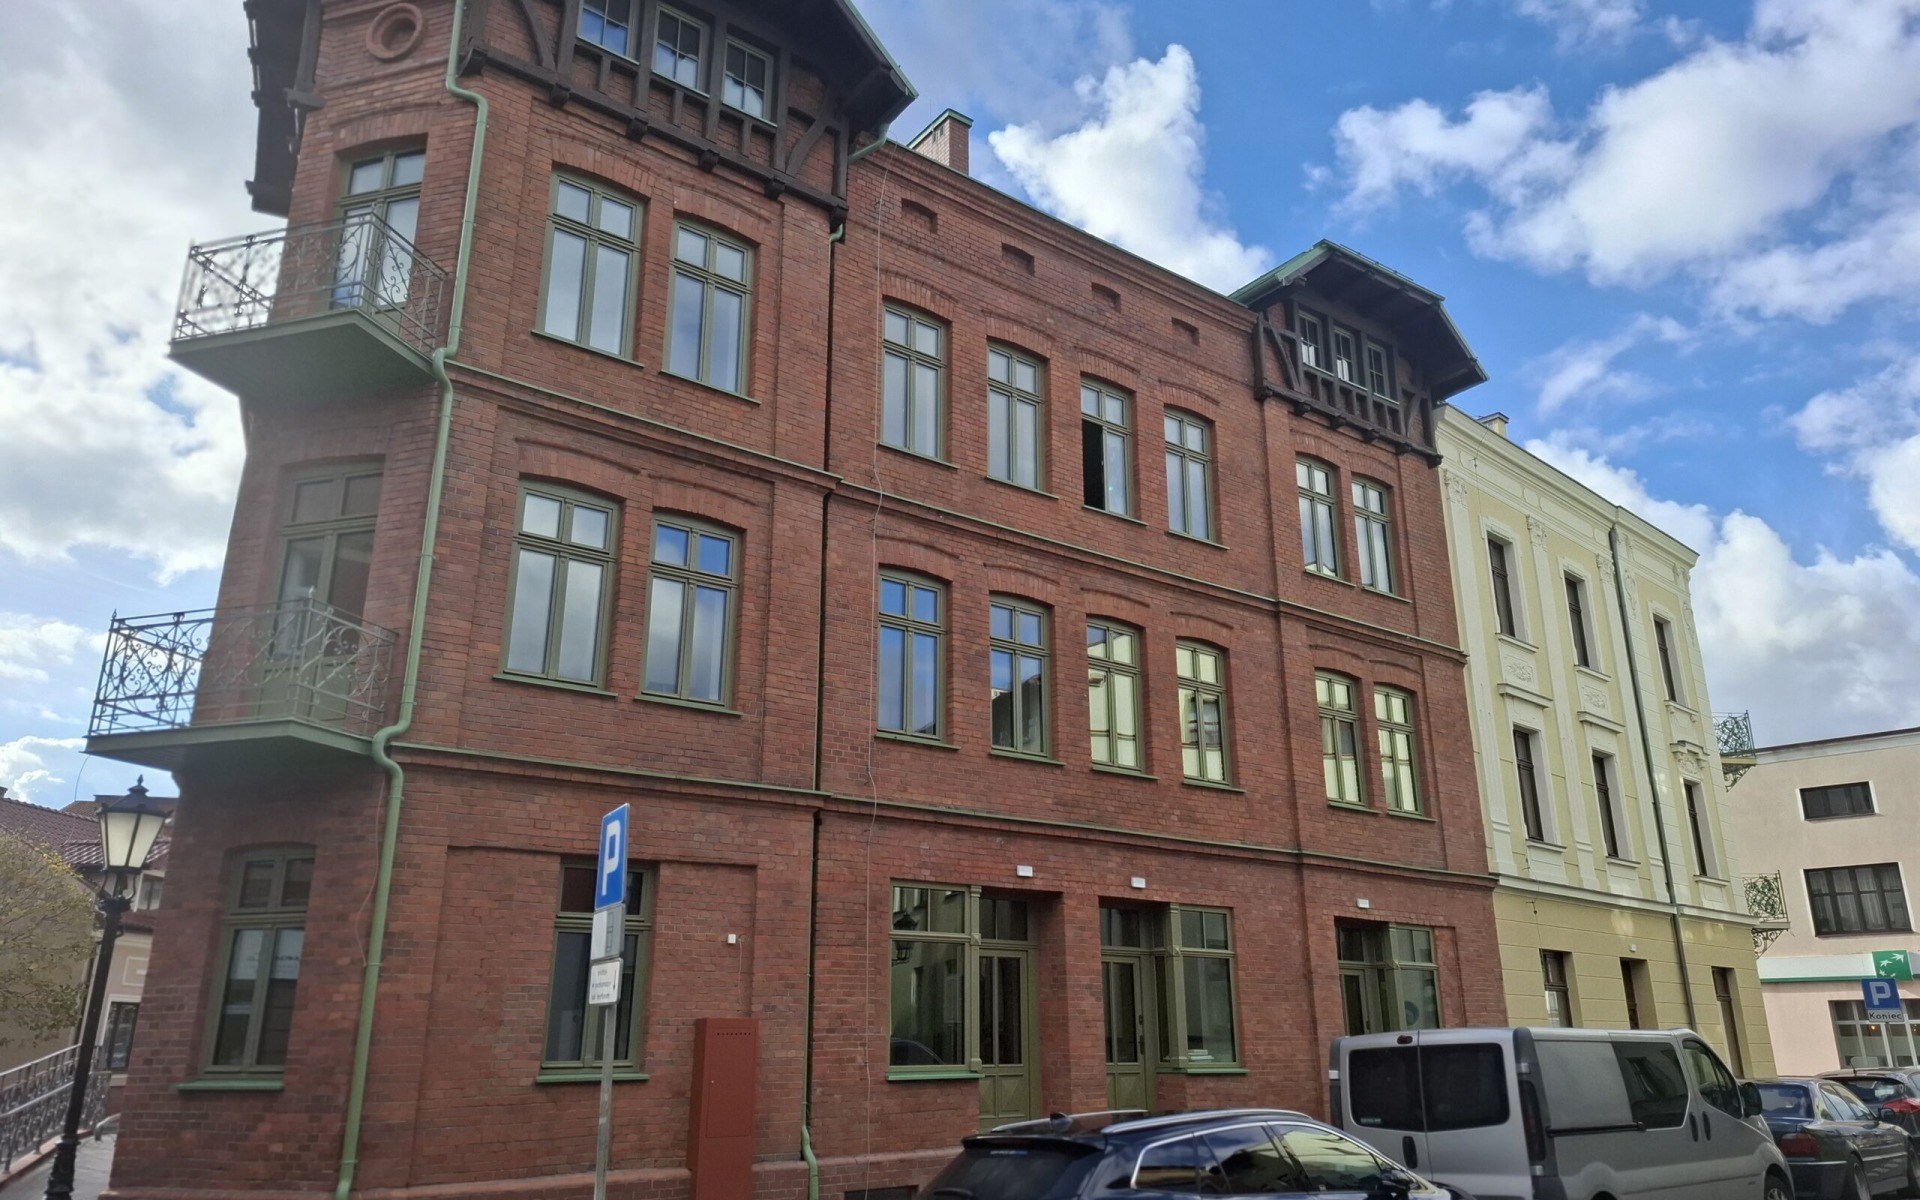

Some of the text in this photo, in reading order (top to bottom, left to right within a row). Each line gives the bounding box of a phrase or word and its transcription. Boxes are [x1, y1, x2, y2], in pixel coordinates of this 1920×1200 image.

[601, 820, 620, 896] P
[1869, 981, 1891, 1005] P
[1869, 1012, 1902, 1020] Koniec
